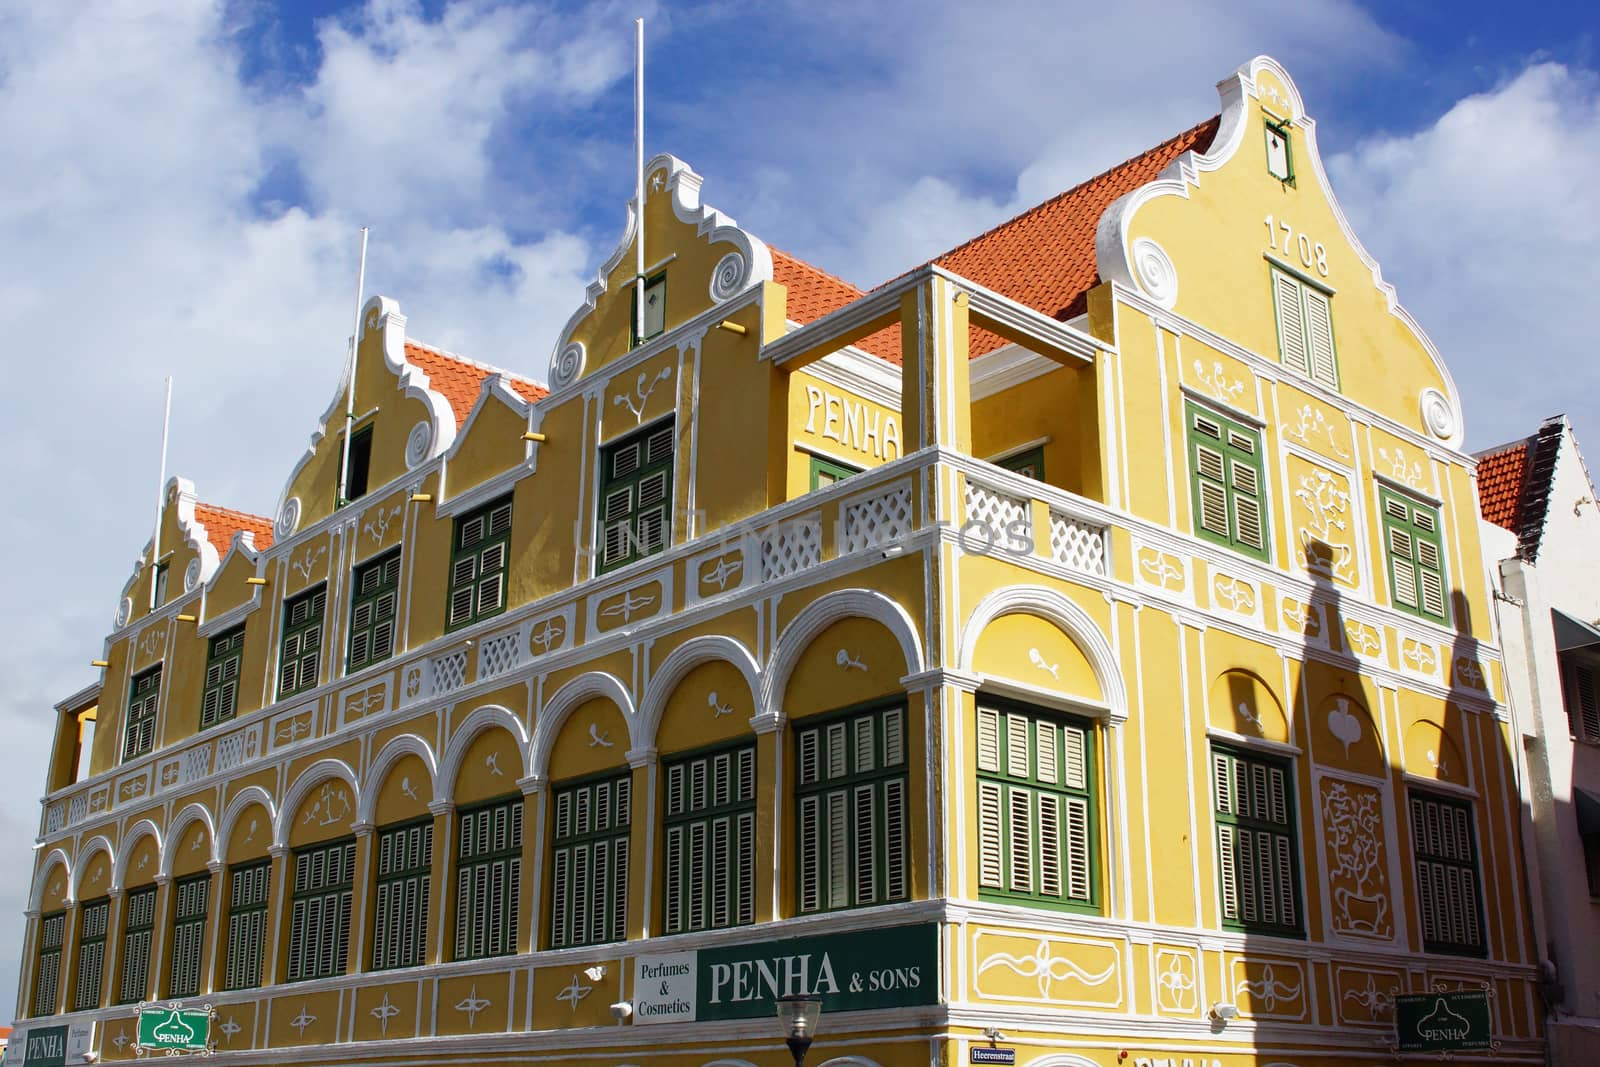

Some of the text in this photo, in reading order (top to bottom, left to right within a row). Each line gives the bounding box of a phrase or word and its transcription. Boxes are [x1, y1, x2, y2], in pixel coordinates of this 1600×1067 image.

[1264, 214, 1328, 277] 1708
[804, 385, 902, 461] PENHA
[641, 961, 690, 979] Perfumes
[708, 951, 921, 1004] PENHA & SONS
[659, 981, 669, 996] &
[638, 999, 690, 1017] Cosmetics
[159, 1033, 190, 1043] PENHA
[1424, 1028, 1466, 1041] PENHA
[27, 1034, 64, 1060] PENHA
